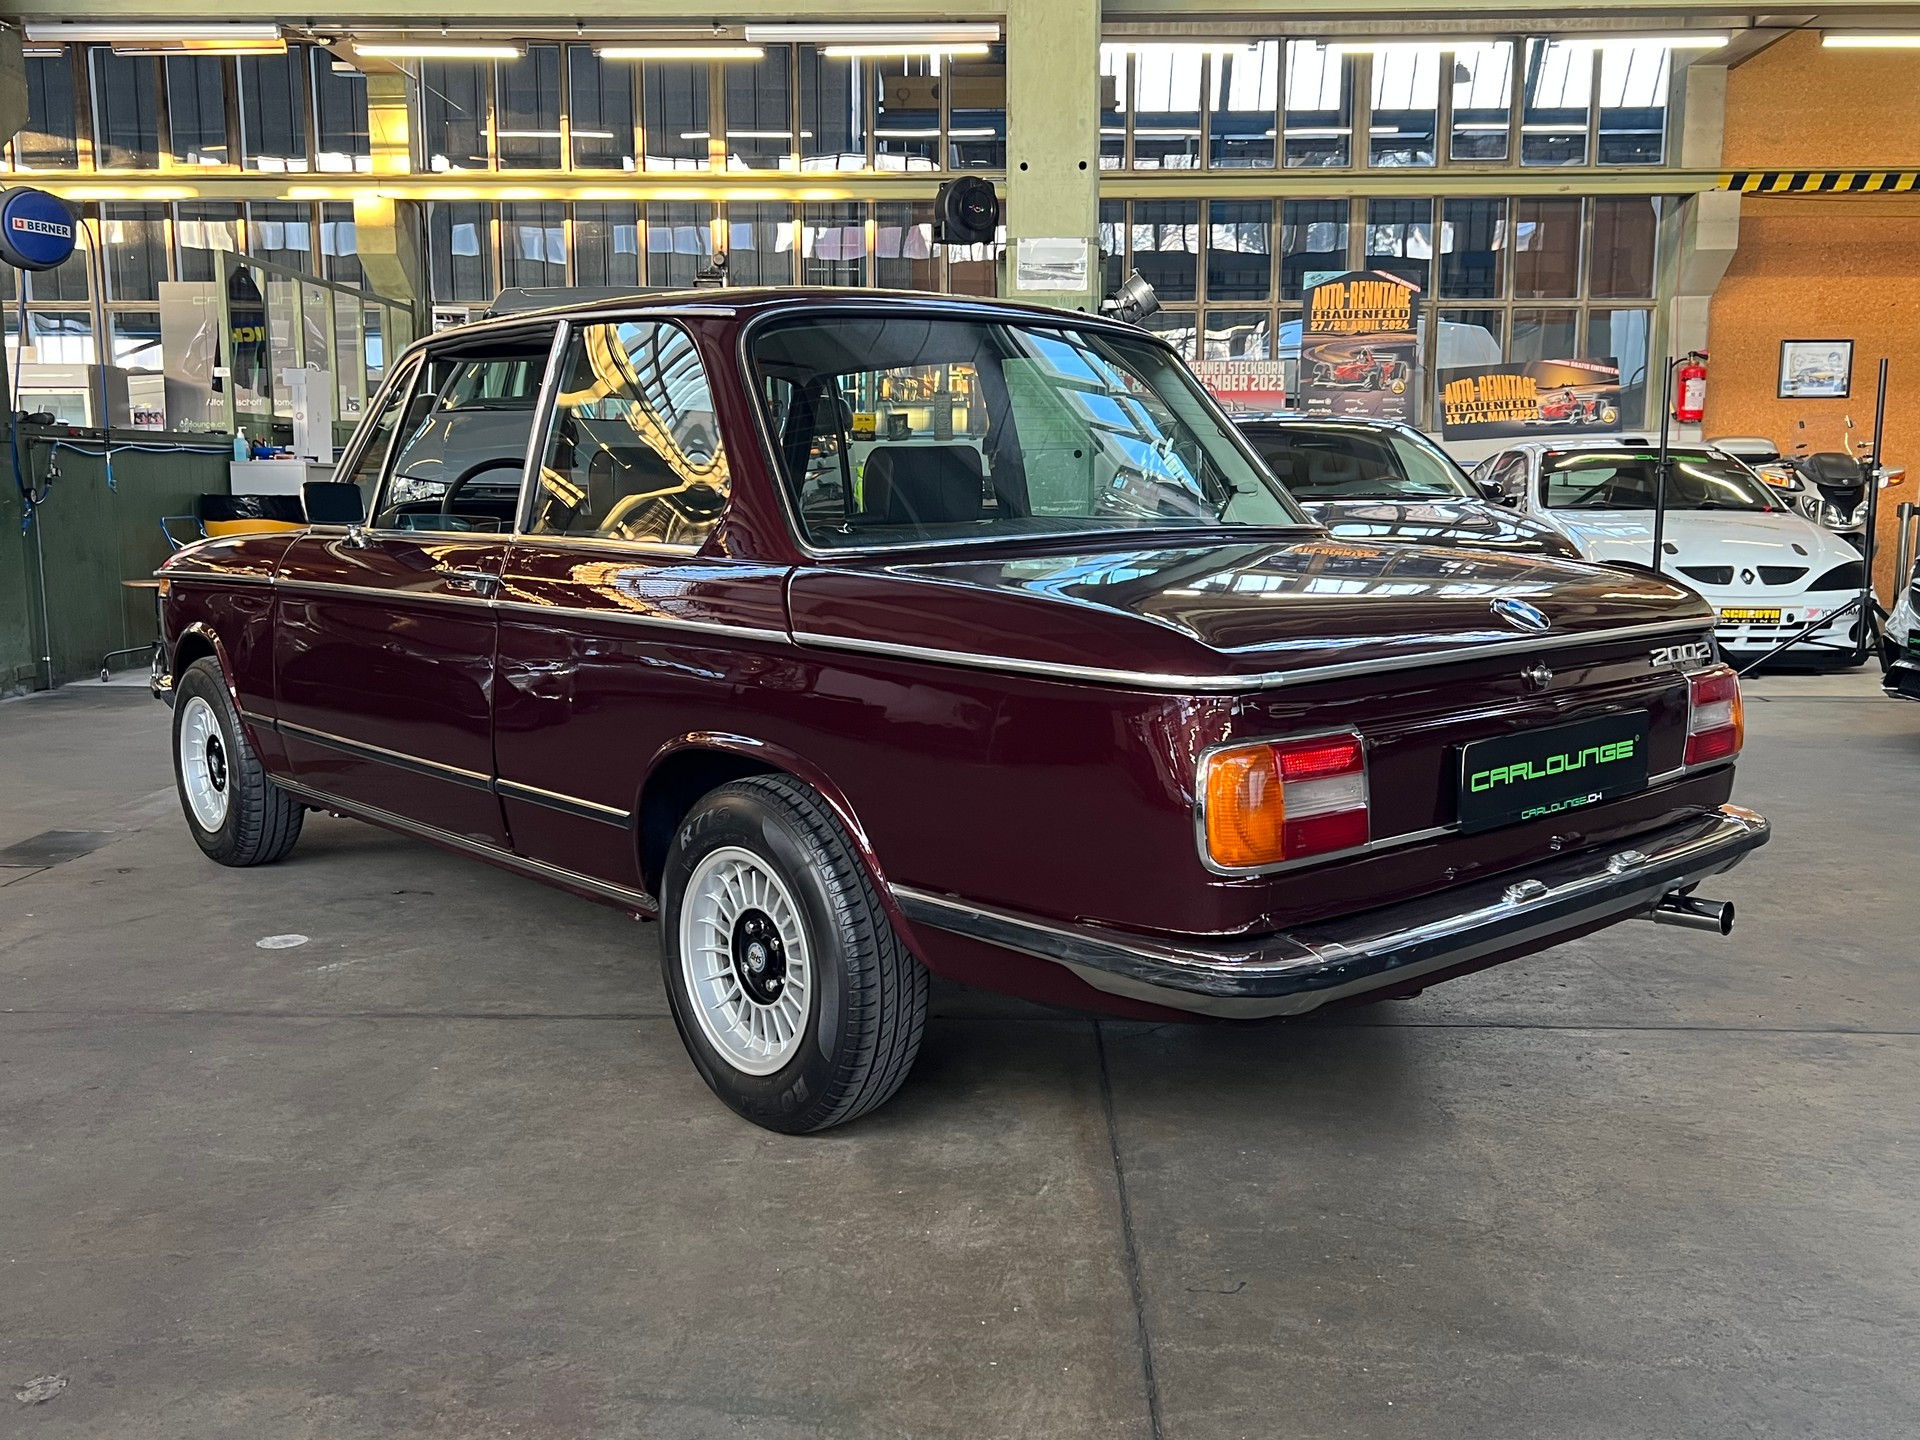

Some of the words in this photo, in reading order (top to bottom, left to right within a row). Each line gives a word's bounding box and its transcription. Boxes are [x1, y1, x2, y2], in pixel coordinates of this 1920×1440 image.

[27, 220, 69, 236] BERNER
[1312, 280, 1411, 310] AUTO-RENNTAGE
[1312, 309, 1410, 320] FRAUENFELD
[1381, 320, 1410, 331] 2024
[1188, 361, 1227, 375] RENNEN
[1228, 361, 1285, 375] STECKBORN
[1250, 375, 1285, 392] 2023
[1445, 375, 1538, 404] AUTO-RENNTAGE
[1447, 399, 1538, 414] FRAUENFELD
[1510, 409, 1538, 421] 2023
[1721, 609, 1780, 619] SCHROTH
[1649, 641, 1712, 667] 2002
[1471, 739, 1634, 793] CARLOUNGE
[1521, 791, 1603, 820] CARLOUNGE.CH
